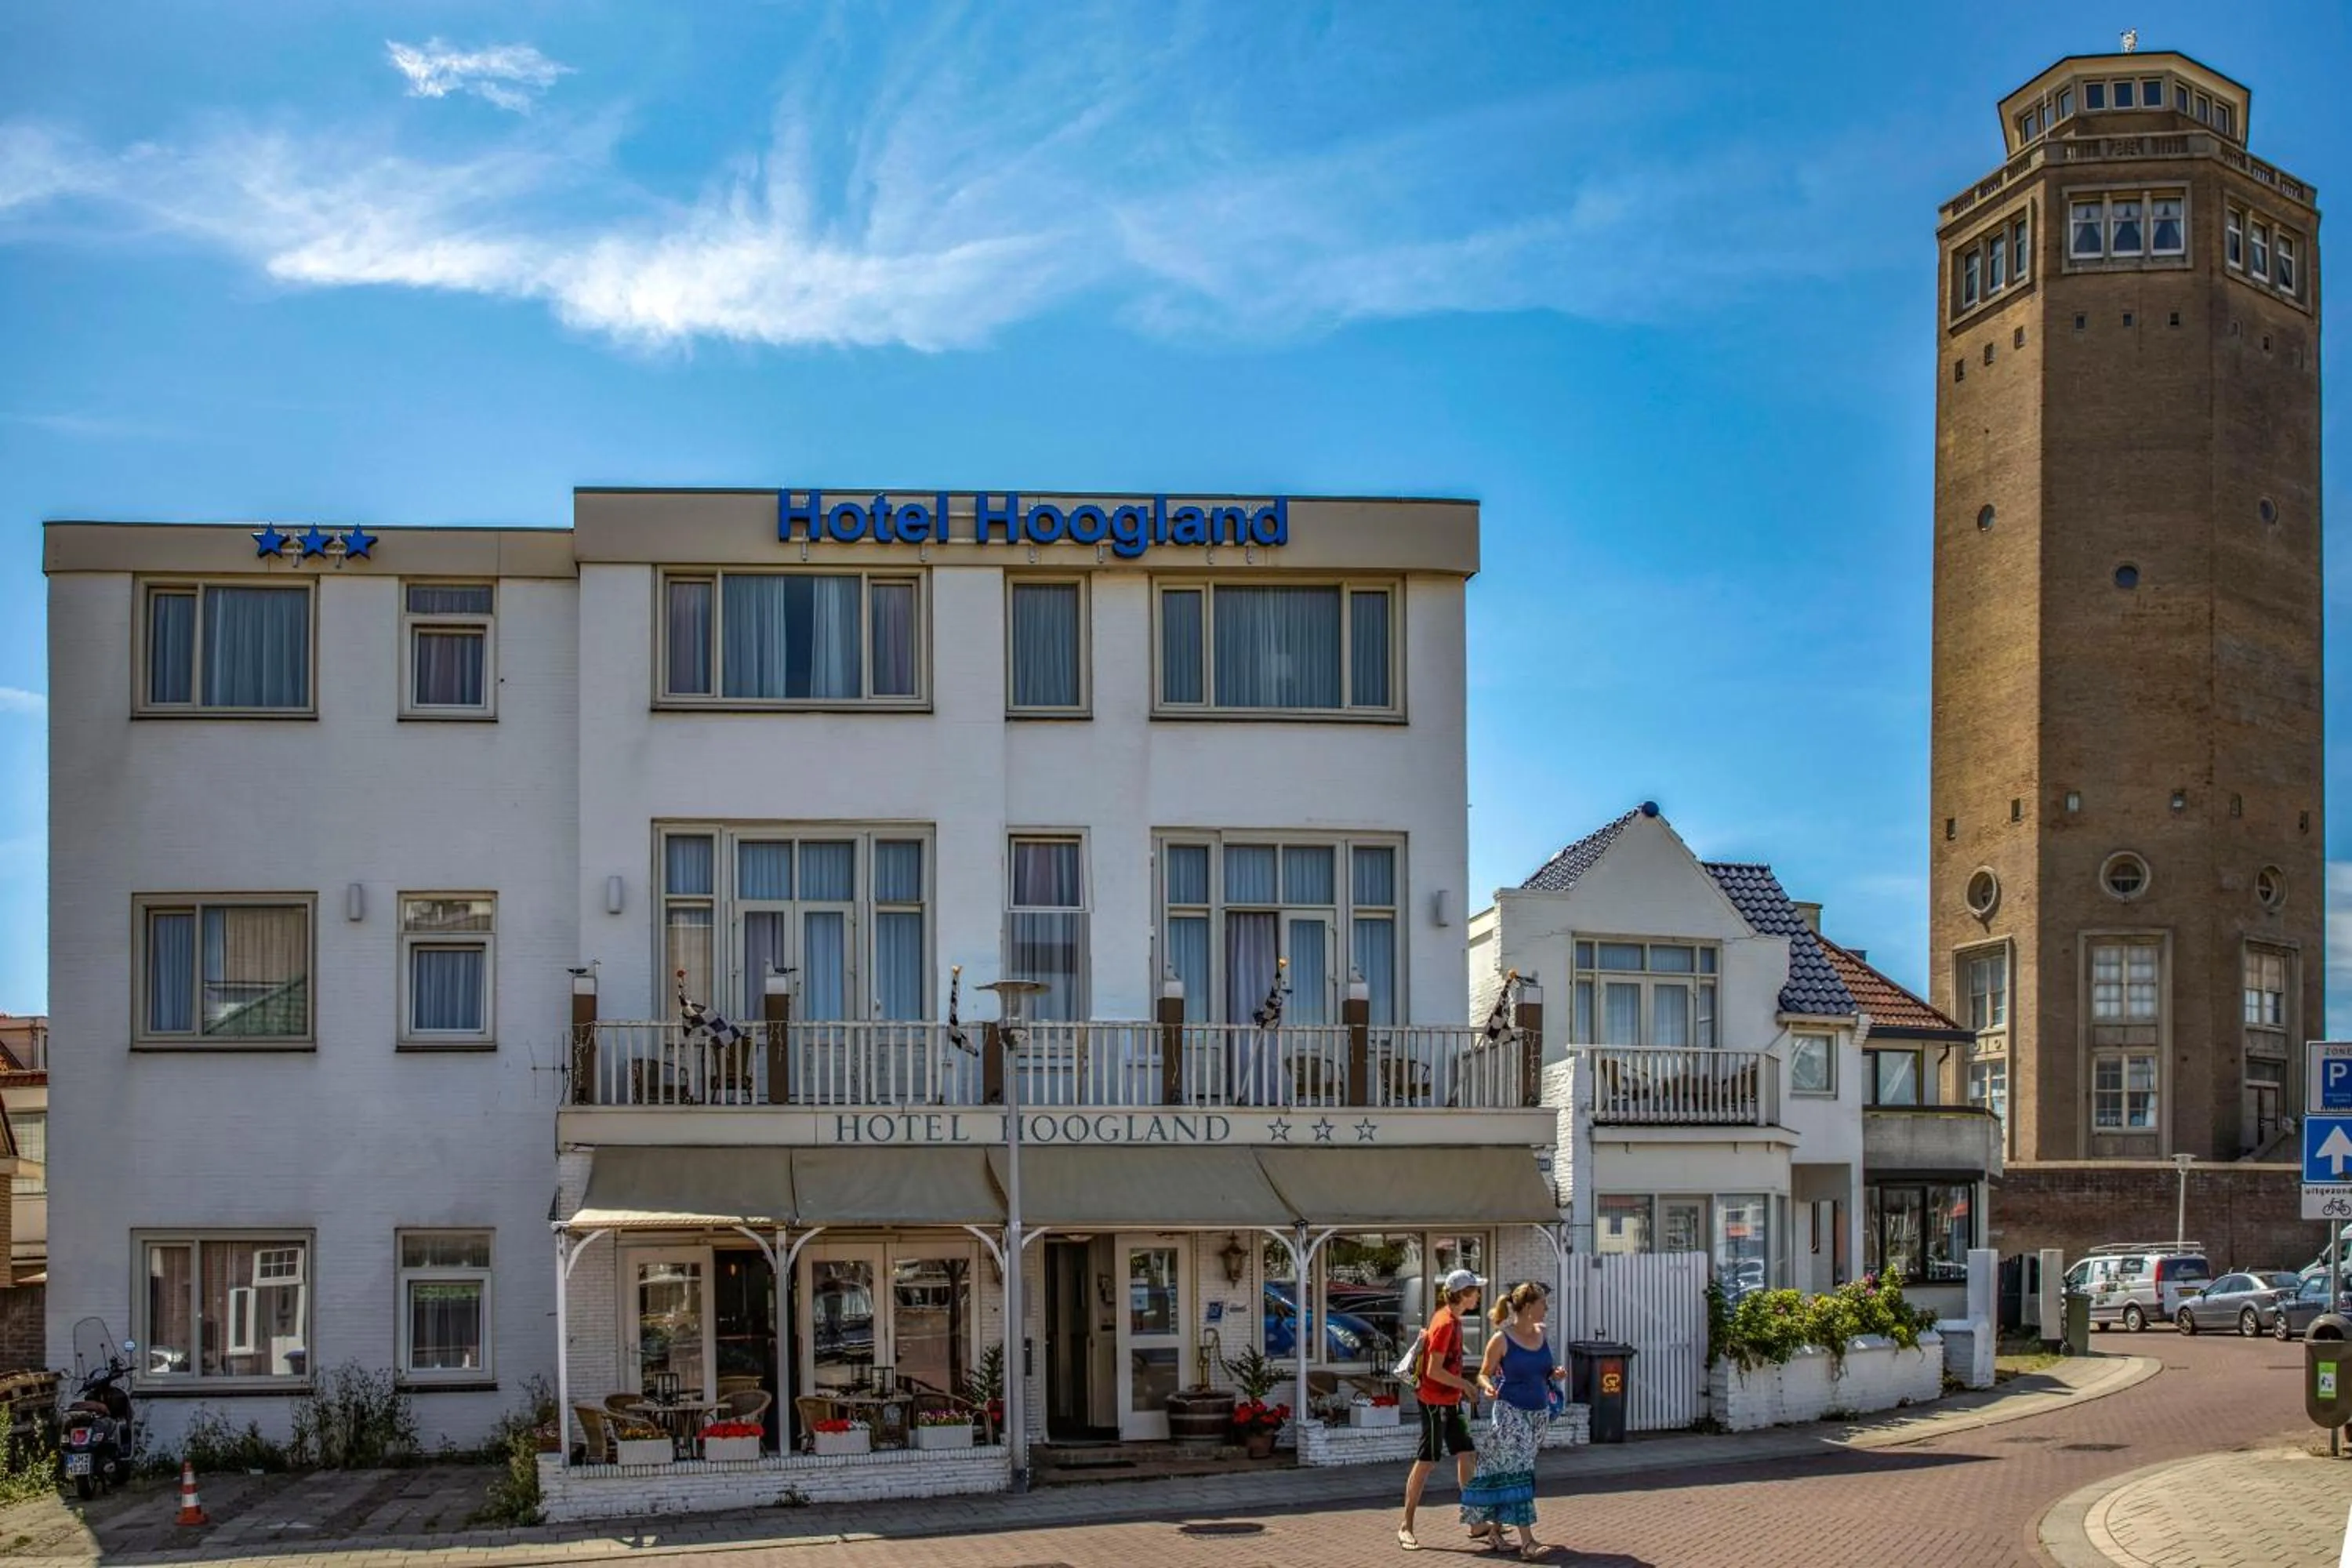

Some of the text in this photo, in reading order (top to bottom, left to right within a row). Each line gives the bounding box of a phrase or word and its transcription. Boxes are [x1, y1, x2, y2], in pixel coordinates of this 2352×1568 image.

[778, 489, 1288, 557] Hotel Hoogland
[2328, 1062, 2348, 1088] P
[835, 1114, 1231, 1142] HOTEL HOOGLAND
